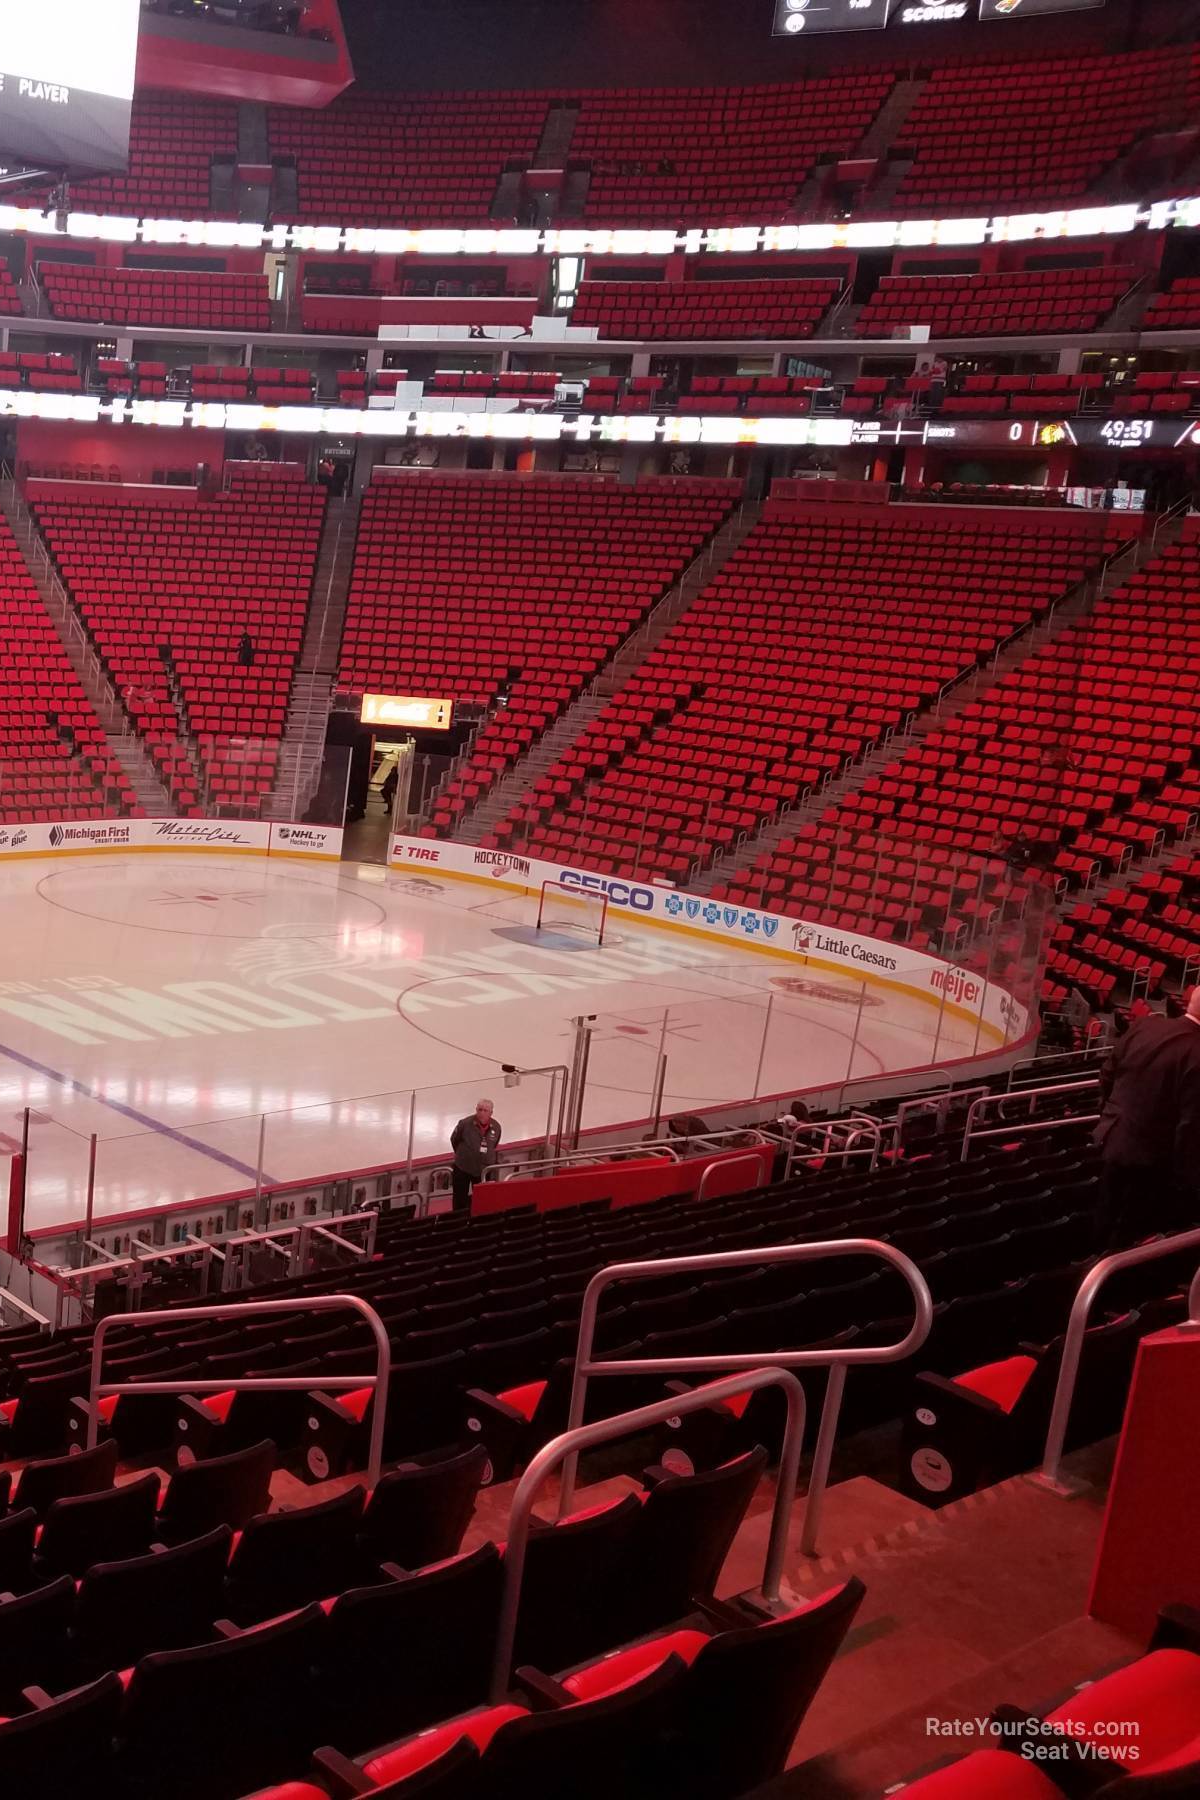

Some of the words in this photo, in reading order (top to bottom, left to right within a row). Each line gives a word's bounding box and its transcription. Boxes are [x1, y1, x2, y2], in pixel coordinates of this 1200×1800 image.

[902, 3, 969, 23] SCORES
[19, 79, 70, 104] PLAYER
[1009, 423, 1022, 440] 0
[1100, 420, 1154, 439] 49:51
[65, 828, 106, 840] Michigan
[108, 826, 130, 837] First
[206, 827, 251, 844] City
[407, 846, 441, 861] TIRE
[474, 851, 530, 875] HOCKEYTOWN
[559, 871, 654, 911] GEICO
[815, 934, 850, 956] Little
[851, 944, 896, 971] Caesars
[930, 968, 980, 1003] meijer
